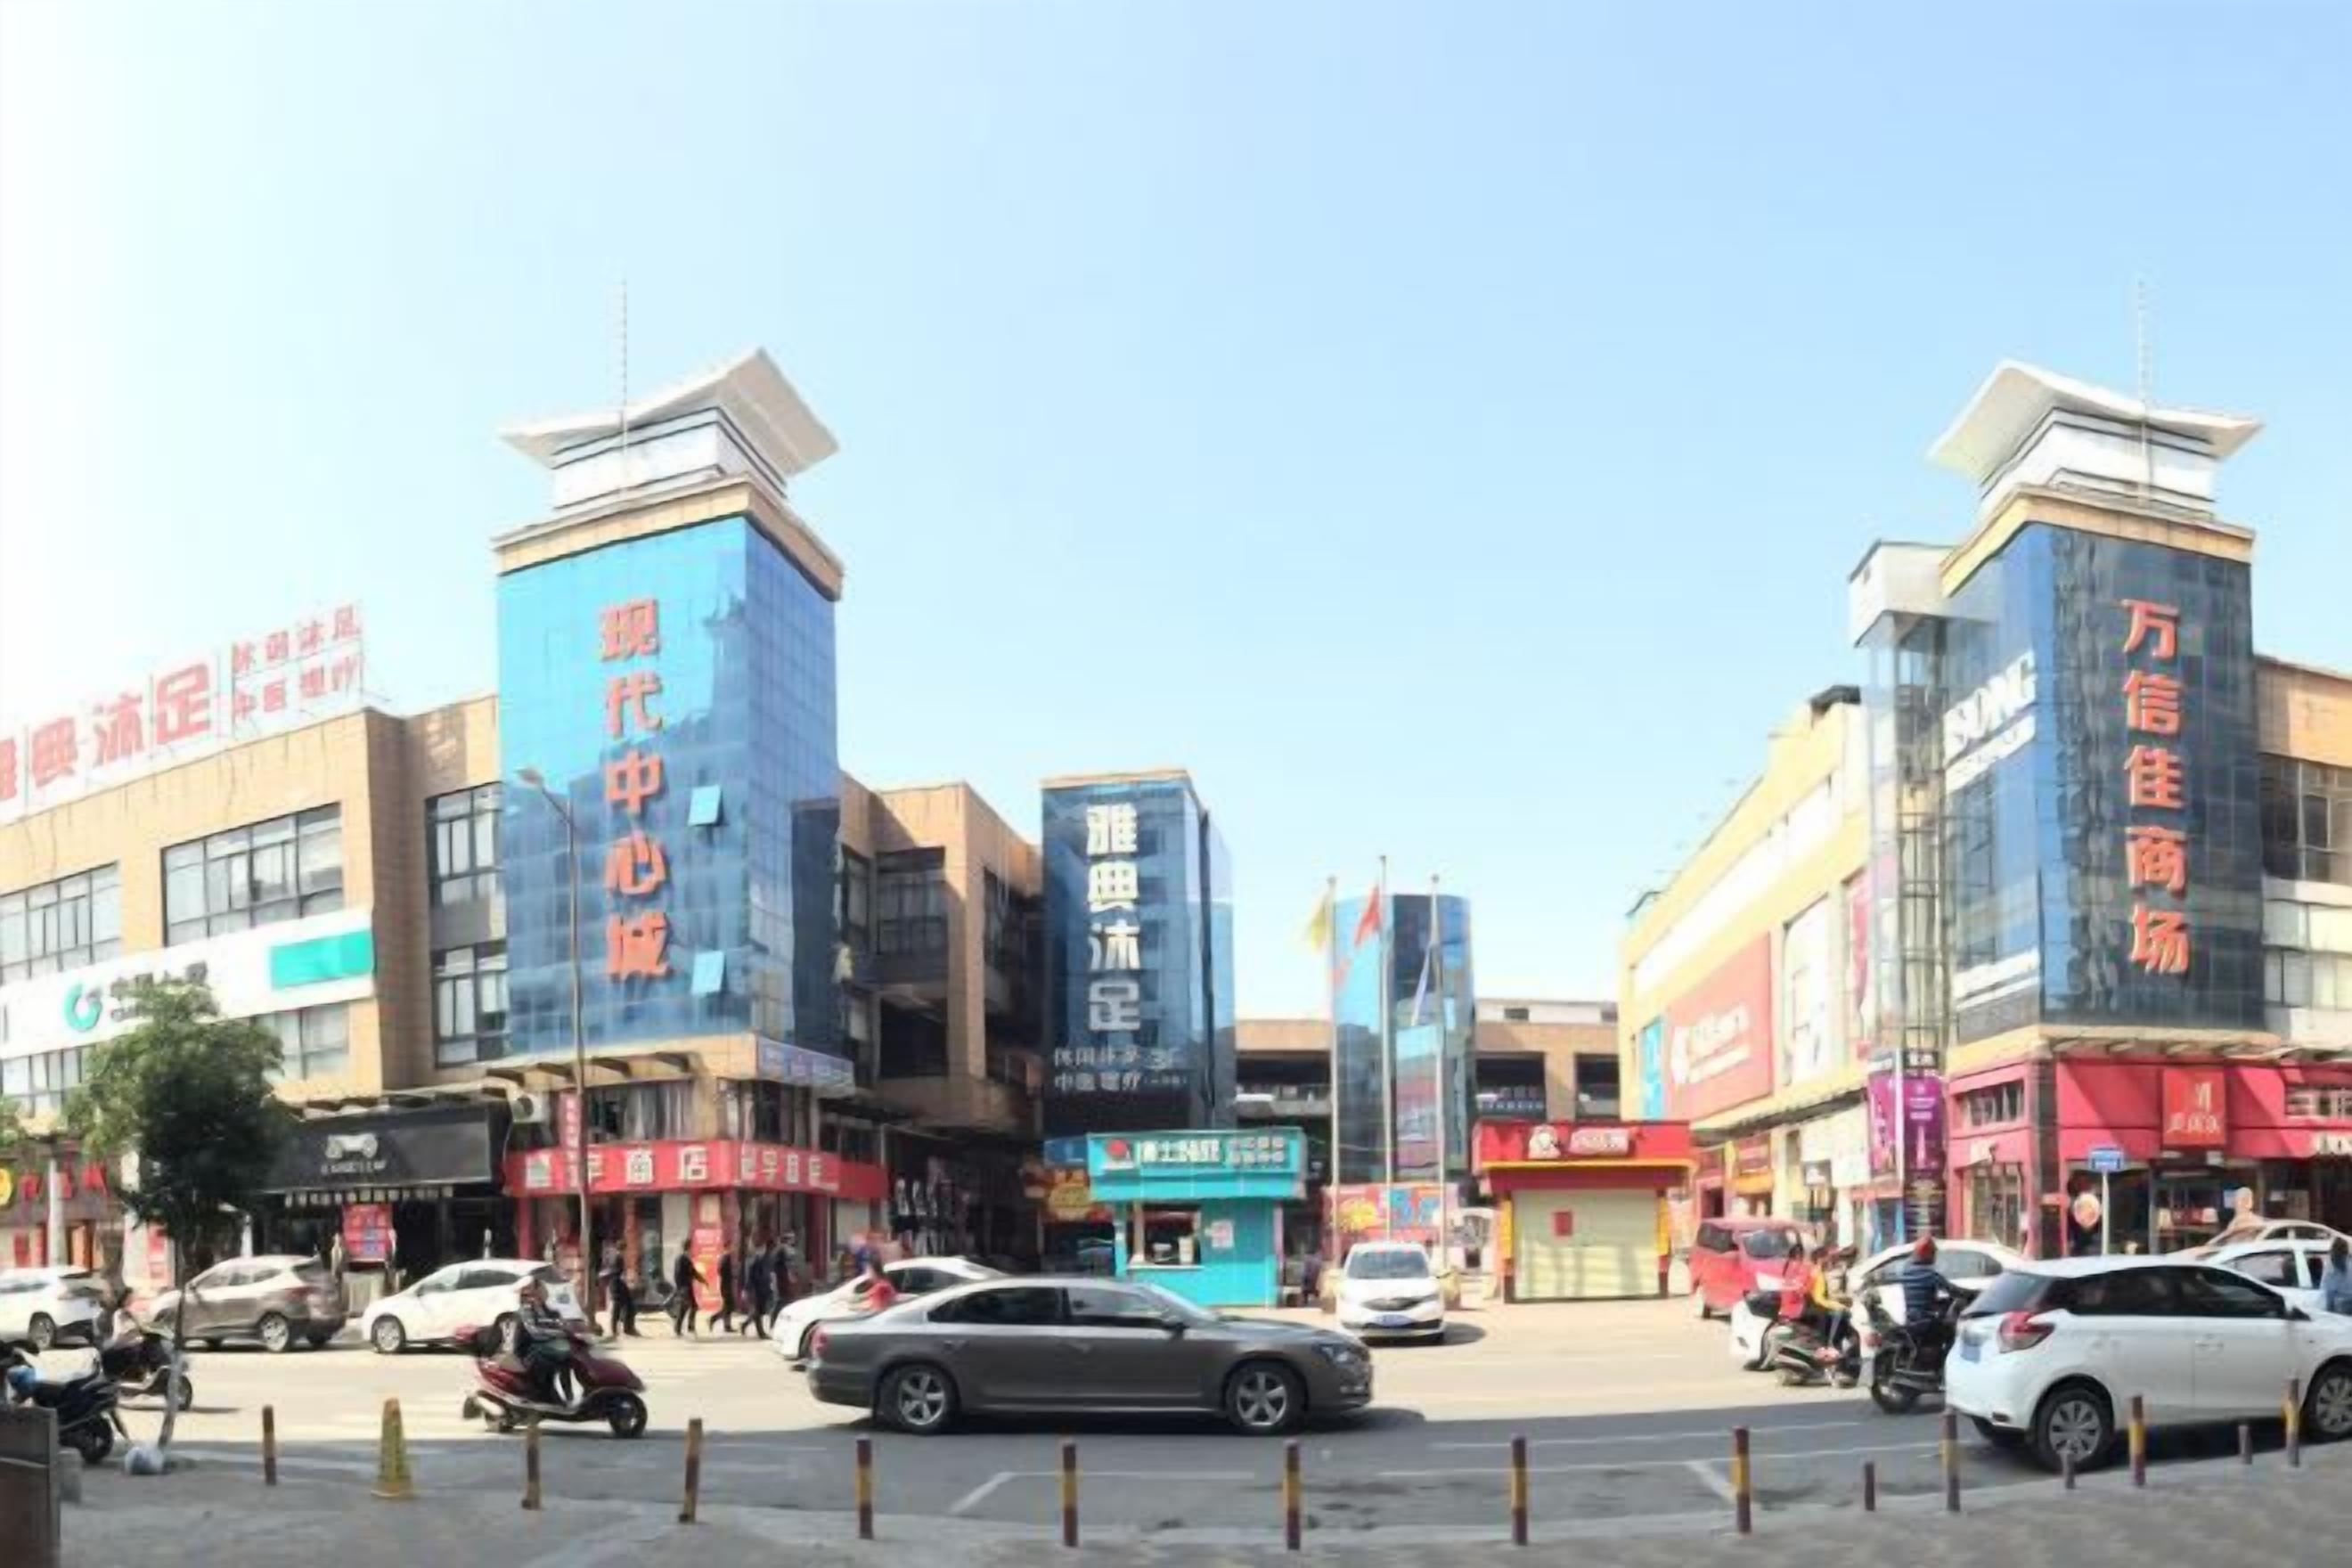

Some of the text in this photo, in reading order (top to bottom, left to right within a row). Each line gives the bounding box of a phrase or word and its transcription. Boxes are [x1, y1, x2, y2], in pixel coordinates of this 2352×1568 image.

[597, 597, 672, 982] 现代中心城
[1086, 802, 1141, 1031] 雅典沐足
[2120, 599, 2191, 973] 万信佳商场
